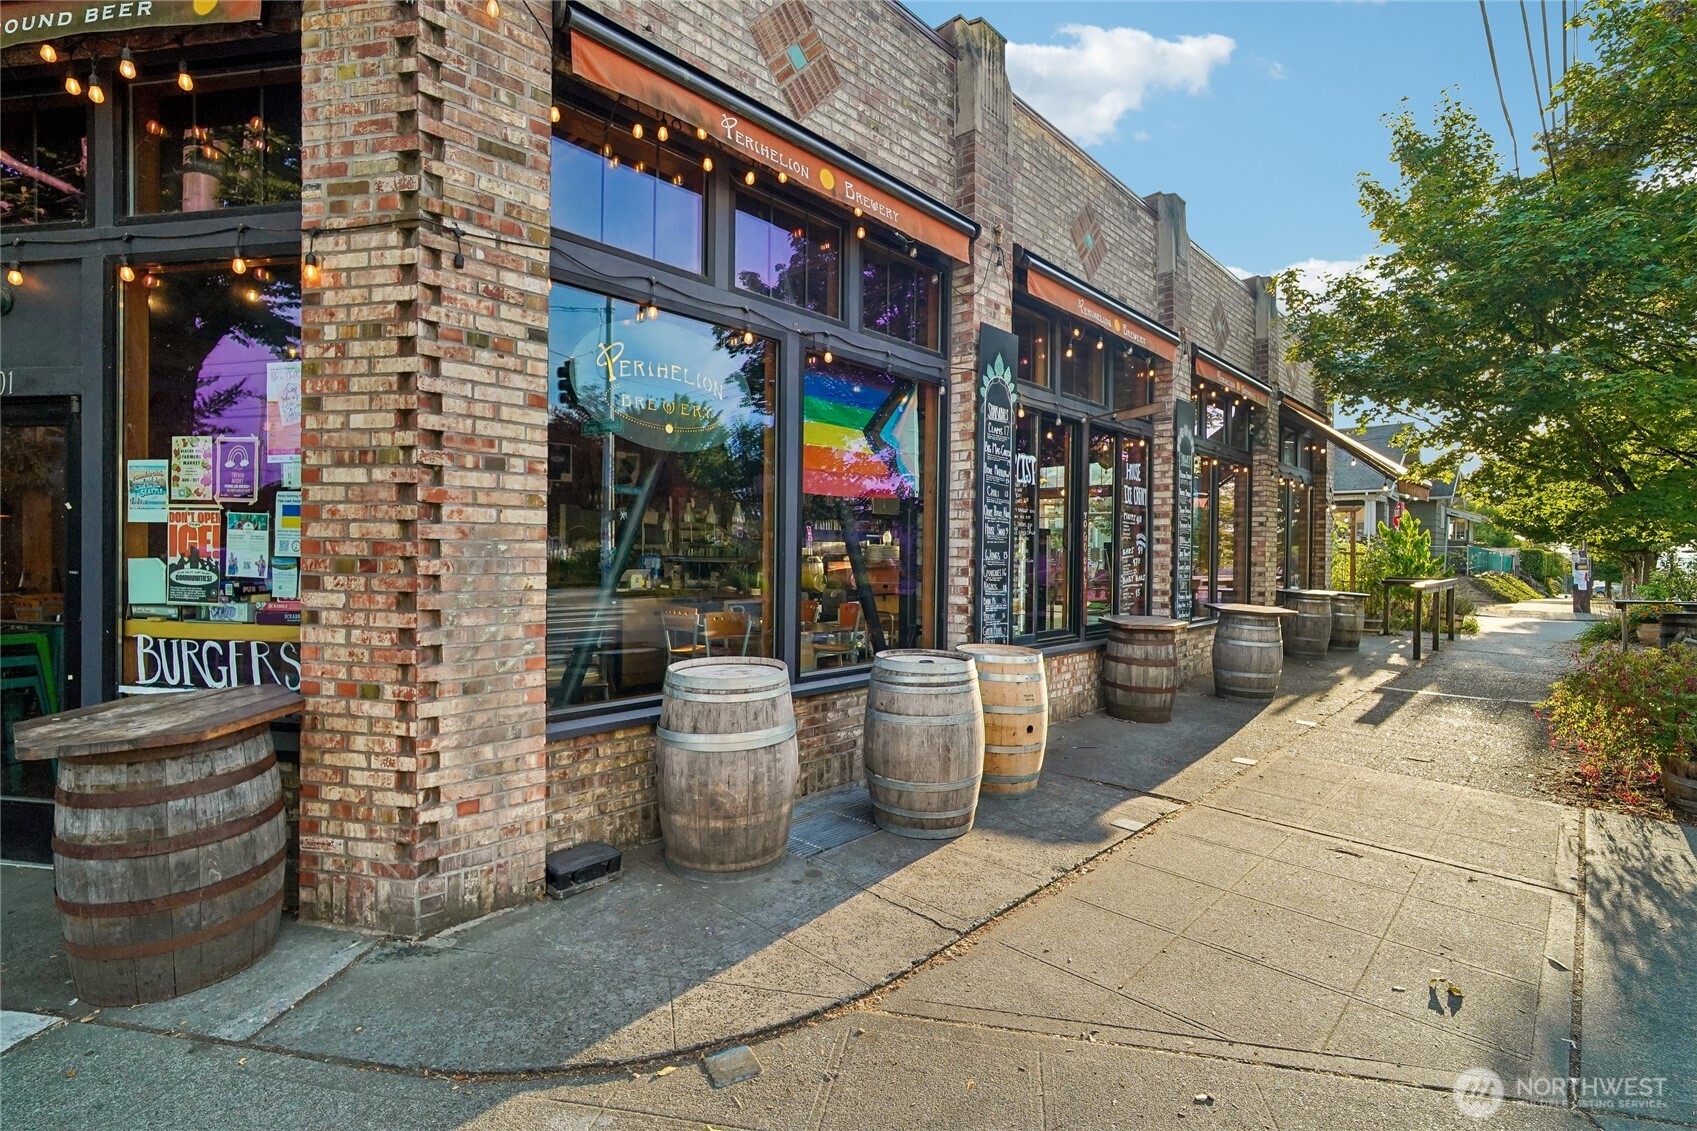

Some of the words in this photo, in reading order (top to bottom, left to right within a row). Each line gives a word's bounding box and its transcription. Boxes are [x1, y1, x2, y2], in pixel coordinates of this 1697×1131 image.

[0, 12, 72, 34] OUND
[85, 2, 152, 24] BEER
[720, 114, 809, 179] PERIHELION
[844, 181, 899, 223] BREWERY
[596, 341, 723, 400] PERIHELION
[621, 393, 713, 419] BREWERY
[1016, 452, 1037, 486] LIST
[169, 511, 195, 523] DON'T
[197, 511, 220, 523] OPEN
[169, 524, 220, 559] ICE!
[175, 574, 212, 582] COMMUNITIES!
[133, 634, 300, 691] BURGERS
